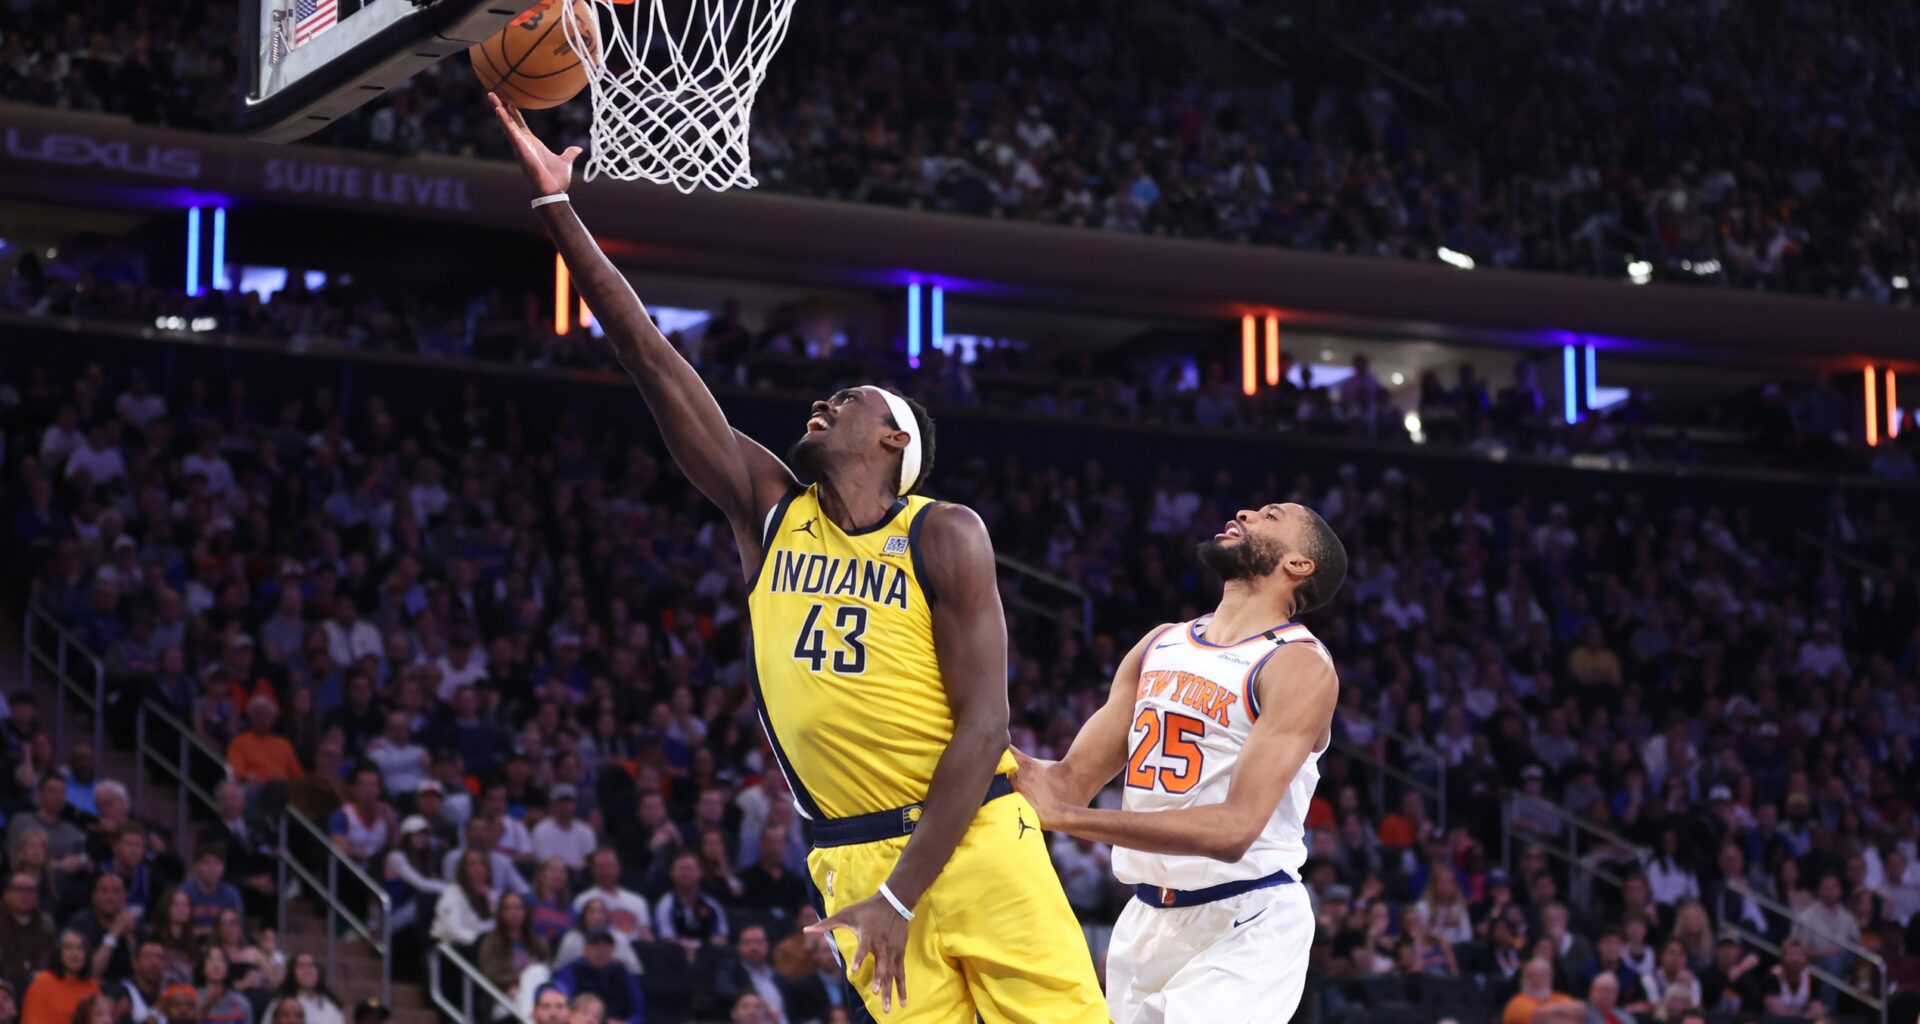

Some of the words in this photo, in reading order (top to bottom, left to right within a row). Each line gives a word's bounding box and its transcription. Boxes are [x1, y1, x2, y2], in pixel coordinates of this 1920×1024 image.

[5, 127, 200, 178] LEXUS
[265, 159, 362, 199] SUITE
[373, 167, 471, 211] LEVEL
[770, 549, 908, 610] INDIANA
[793, 604, 869, 674] 43
[1136, 669, 1178, 700] EW
[1171, 671, 1238, 728] YORK
[1126, 707, 1205, 794] 25
